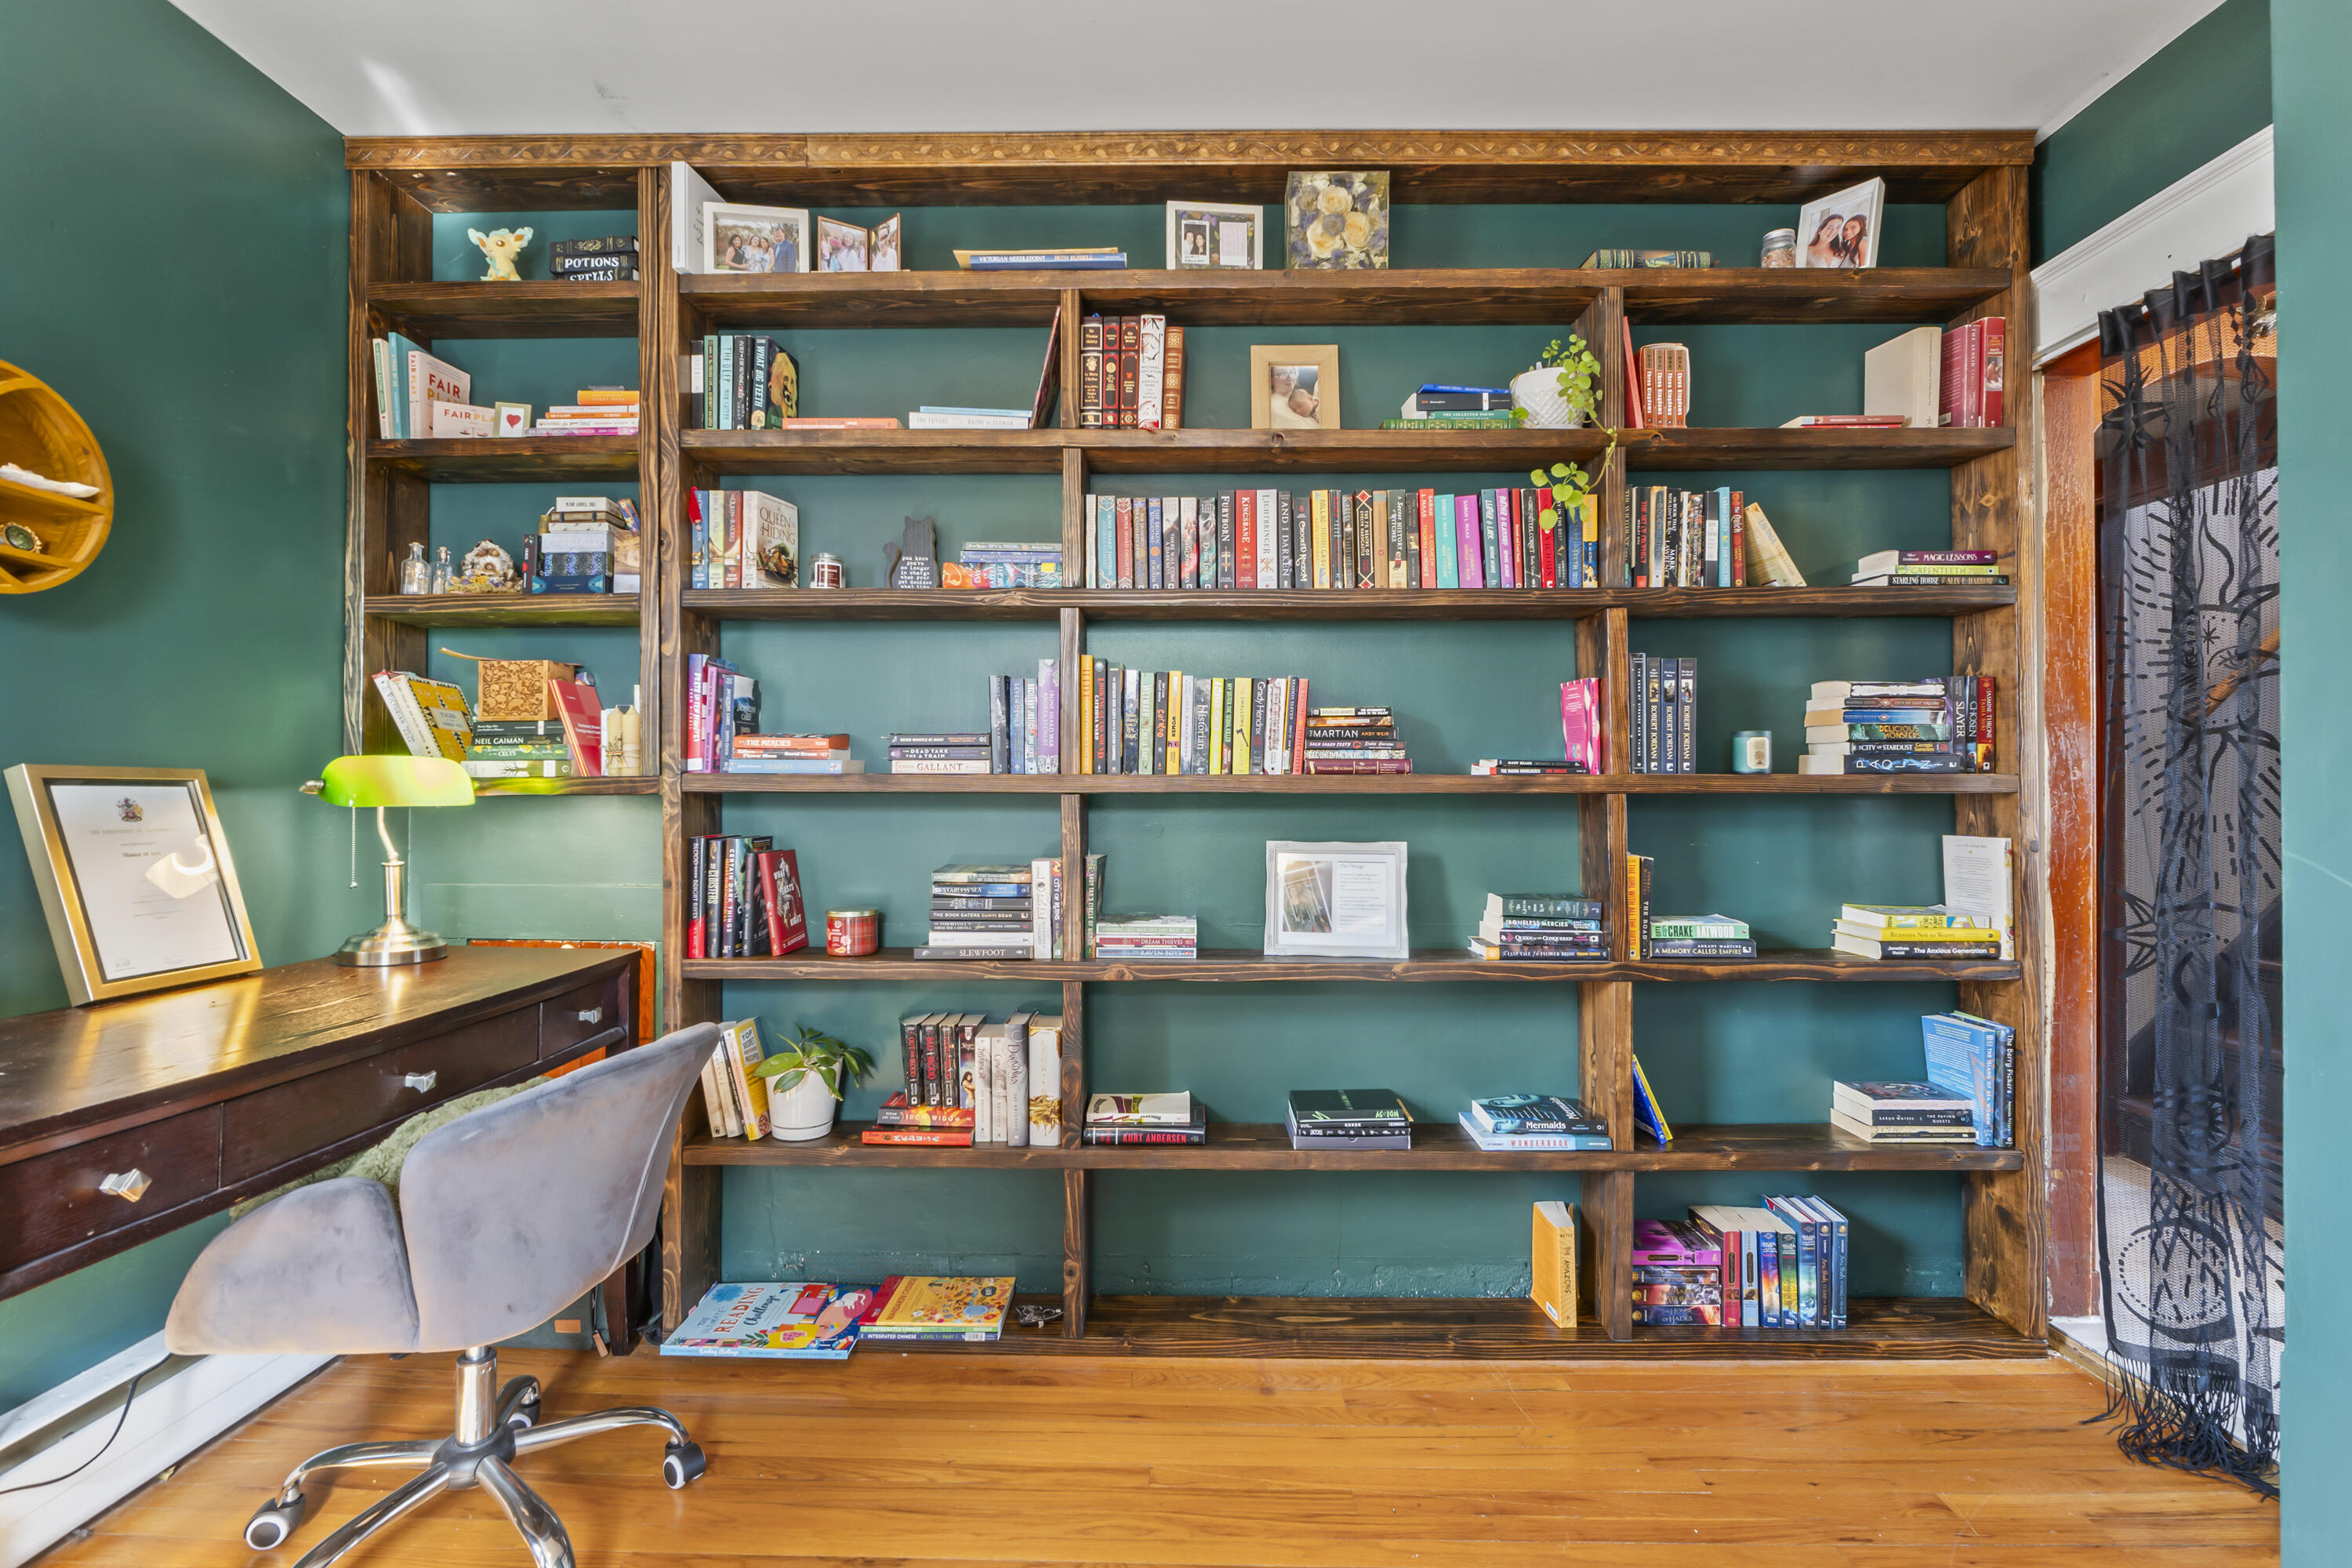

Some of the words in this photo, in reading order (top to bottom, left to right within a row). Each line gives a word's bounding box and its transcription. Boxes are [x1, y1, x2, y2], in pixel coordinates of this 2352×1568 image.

[564, 256, 619, 268] POTIONS
[570, 270, 613, 281] SPELLS
[723, 347, 731, 362] THE
[756, 345, 765, 368] WHAT
[722, 364, 731, 383] DEEP
[755, 369, 764, 379] BIG
[429, 373, 461, 398] FAIR
[754, 383, 764, 407] TEETH
[1499, 496, 1508, 516] BUTCHER
[759, 507, 791, 528] QUEEN
[1221, 495, 1230, 542] FURYBORN
[1262, 495, 1271, 554] LIGHTBRINGER
[1730, 514, 1742, 533] Quick
[760, 523, 796, 545] HIDING
[1298, 521, 1307, 553] CROOKED
[1758, 518, 1777, 544] LAVINIA
[1295, 554, 1308, 582] KINGDOM
[1923, 554, 1944, 562] MAGIC
[1893, 576, 1919, 585] STARLING
[1920, 576, 1940, 585] HOUSE
[1255, 681, 1265, 705] Grady
[1197, 704, 1208, 750] Historian
[1255, 706, 1264, 735] Hendrix
[1956, 701, 1965, 738] SLAYER
[1969, 701, 1977, 737] CHOSEN
[1313, 729, 1359, 738] MARTIAN
[1856, 758, 1944, 772] PAOLINI
[707, 869, 719, 904] CLOISTERS
[1668, 925, 1693, 938] CRAKE
[927, 1055, 935, 1080] BLOOD
[2005, 1048, 2013, 1067] Berry
[1526, 1121, 1566, 1130] Mermaids
[1123, 1133, 1143, 1142] KURT
[1145, 1133, 1187, 1143] ANDERSEN
[713, 1287, 765, 1334] READING
[743, 1294, 780, 1327] Challenge
